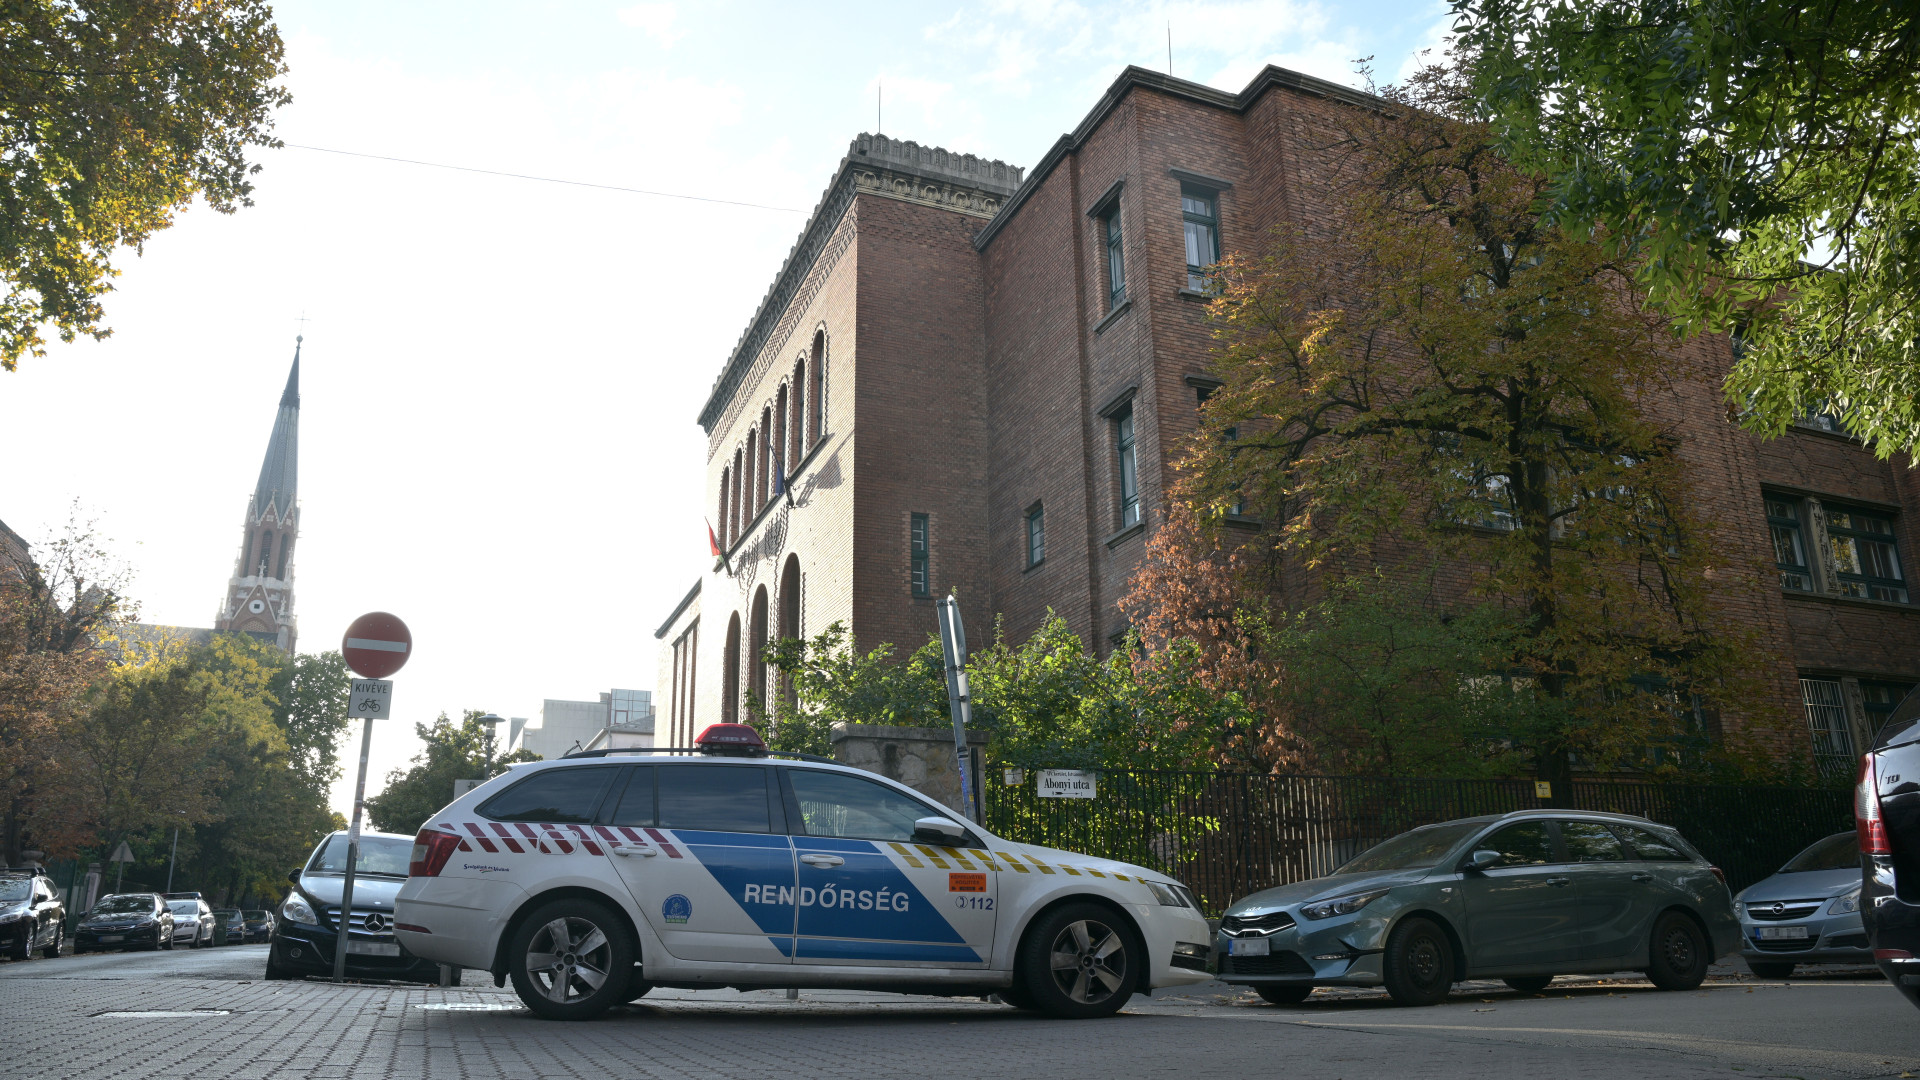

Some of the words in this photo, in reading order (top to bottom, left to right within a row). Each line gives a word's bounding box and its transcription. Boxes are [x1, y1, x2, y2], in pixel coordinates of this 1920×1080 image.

[355, 682, 388, 693] KIVÉVE
[1044, 778, 1071, 791] Abonyi
[1073, 780, 1090, 790] utca
[744, 883, 910, 912] RENDŐRSÉG
[969, 896, 994, 911] 112
